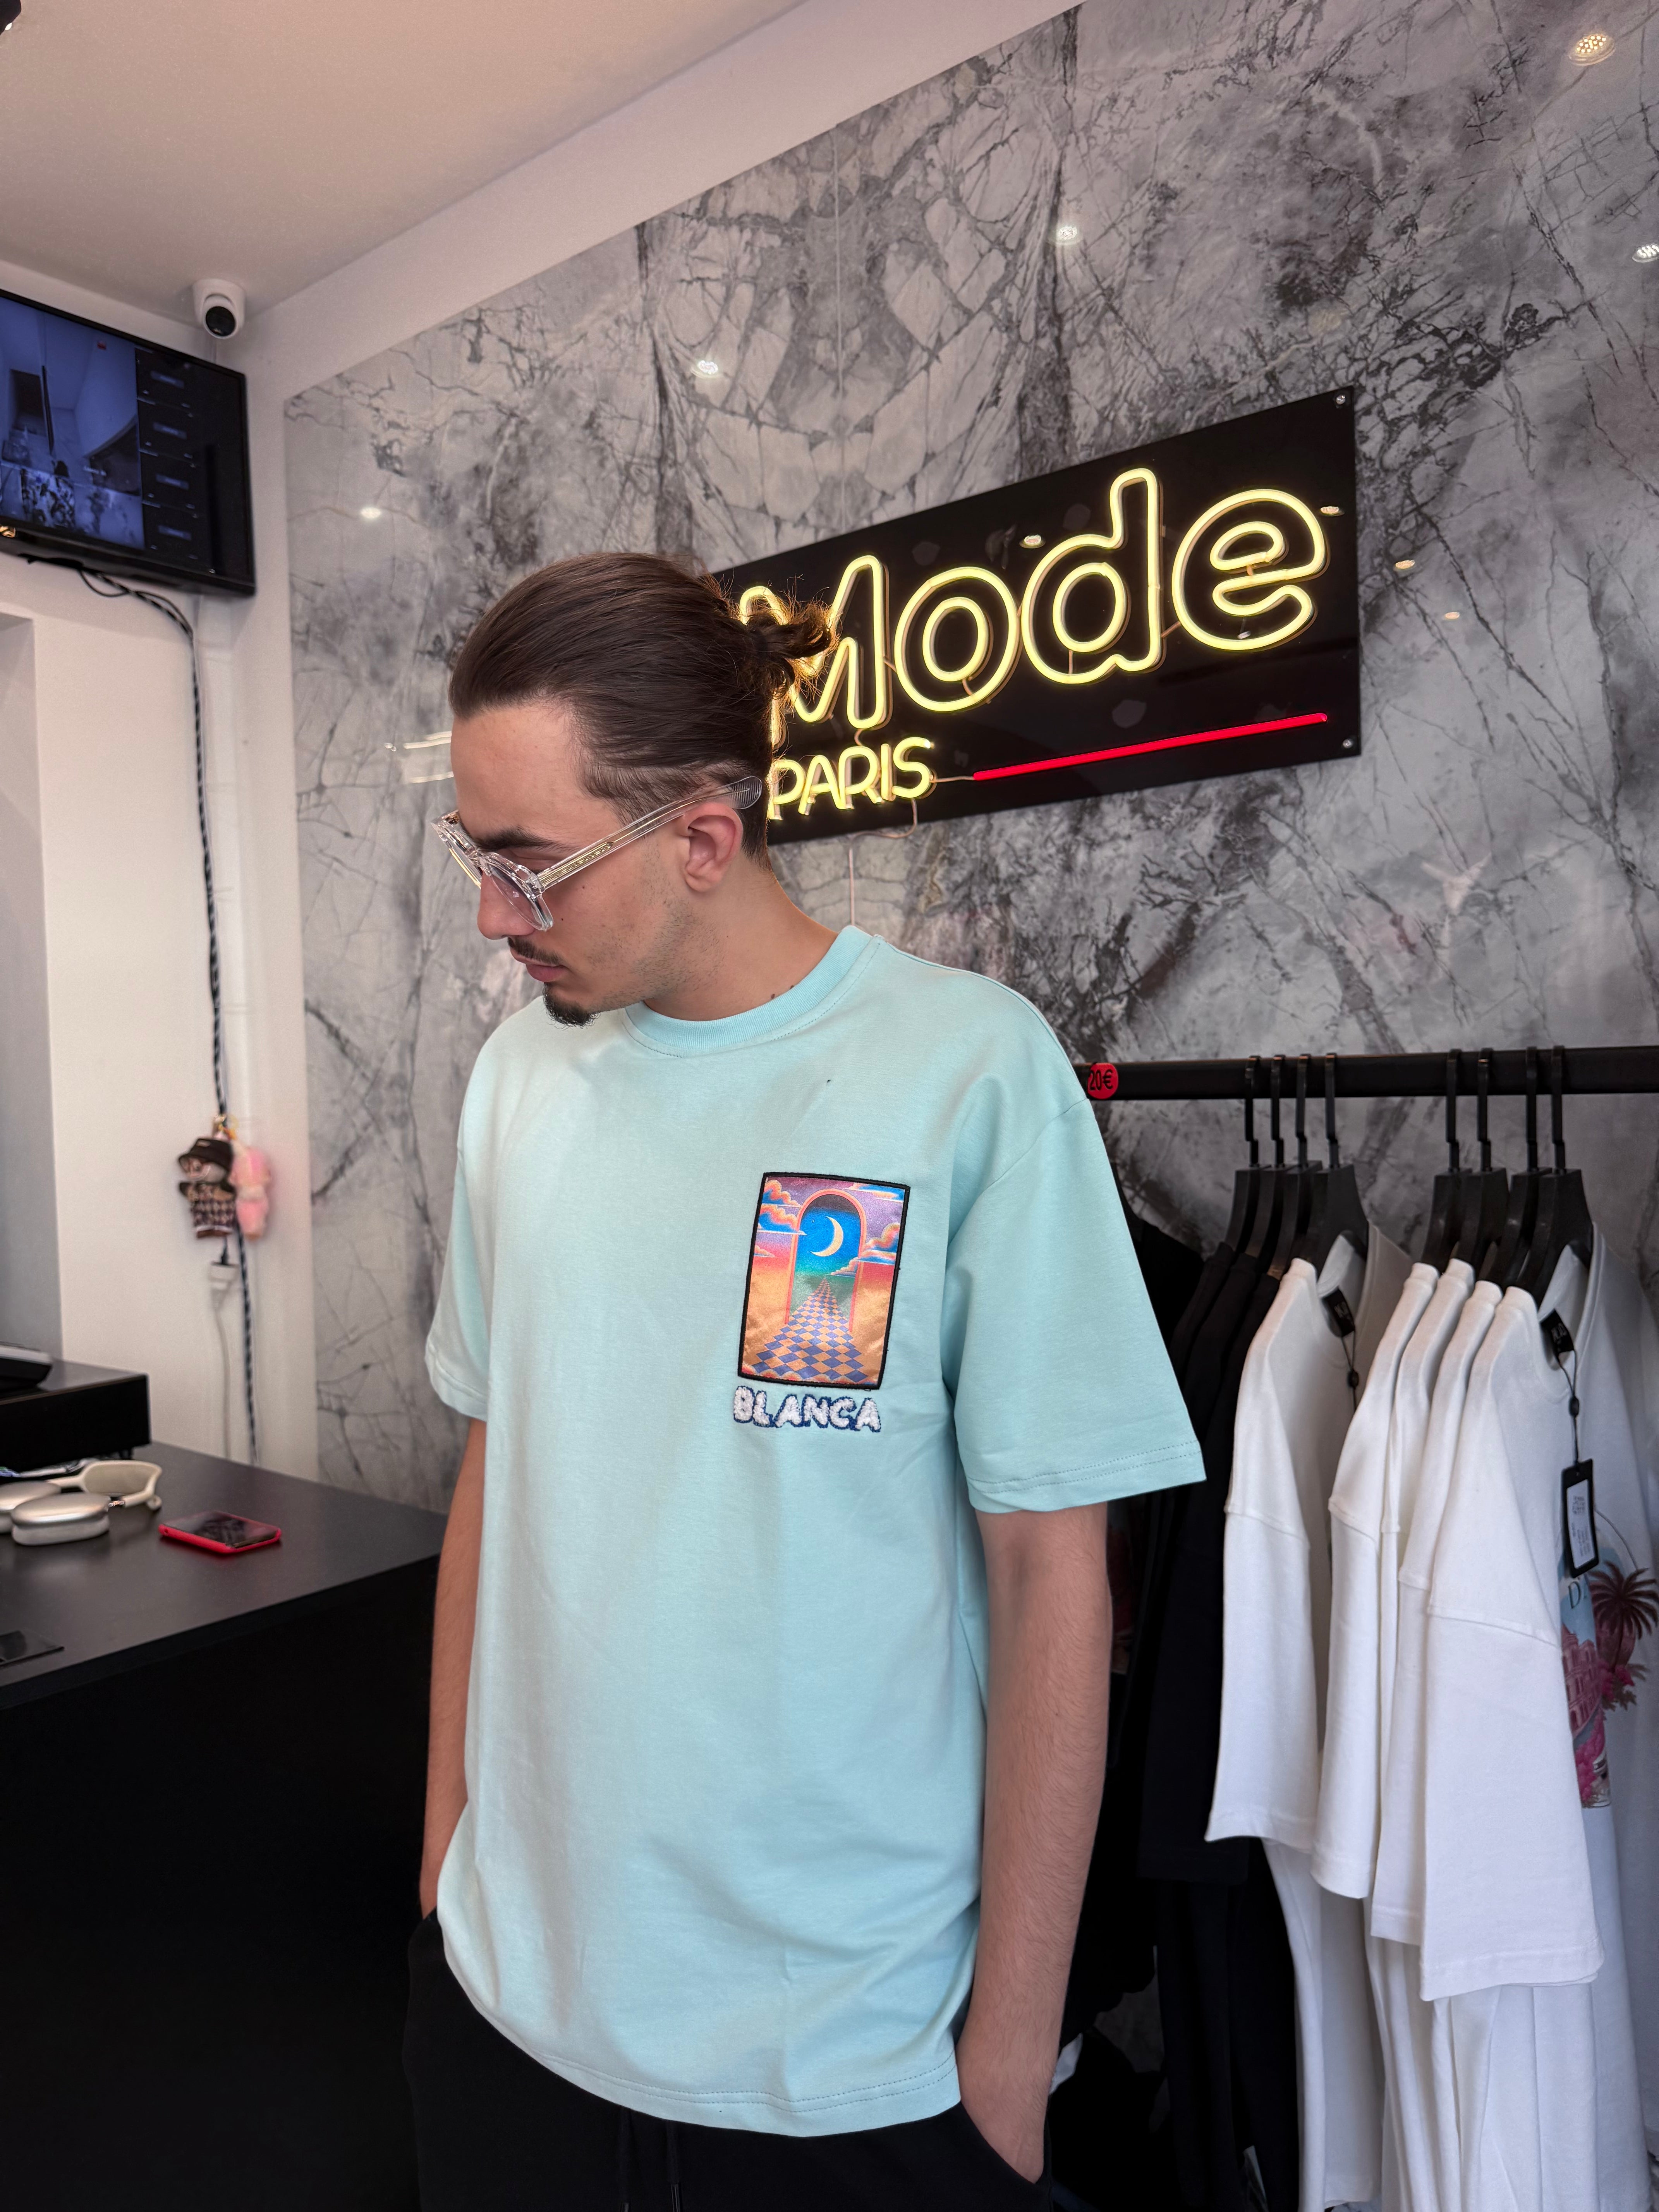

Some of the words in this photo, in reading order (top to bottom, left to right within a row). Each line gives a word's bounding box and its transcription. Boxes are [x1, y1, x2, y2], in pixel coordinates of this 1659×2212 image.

[767, 736, 933, 820] PARIS
[1089, 1069, 1113, 1090] 20€
[733, 1385, 881, 1432] BLANCA
